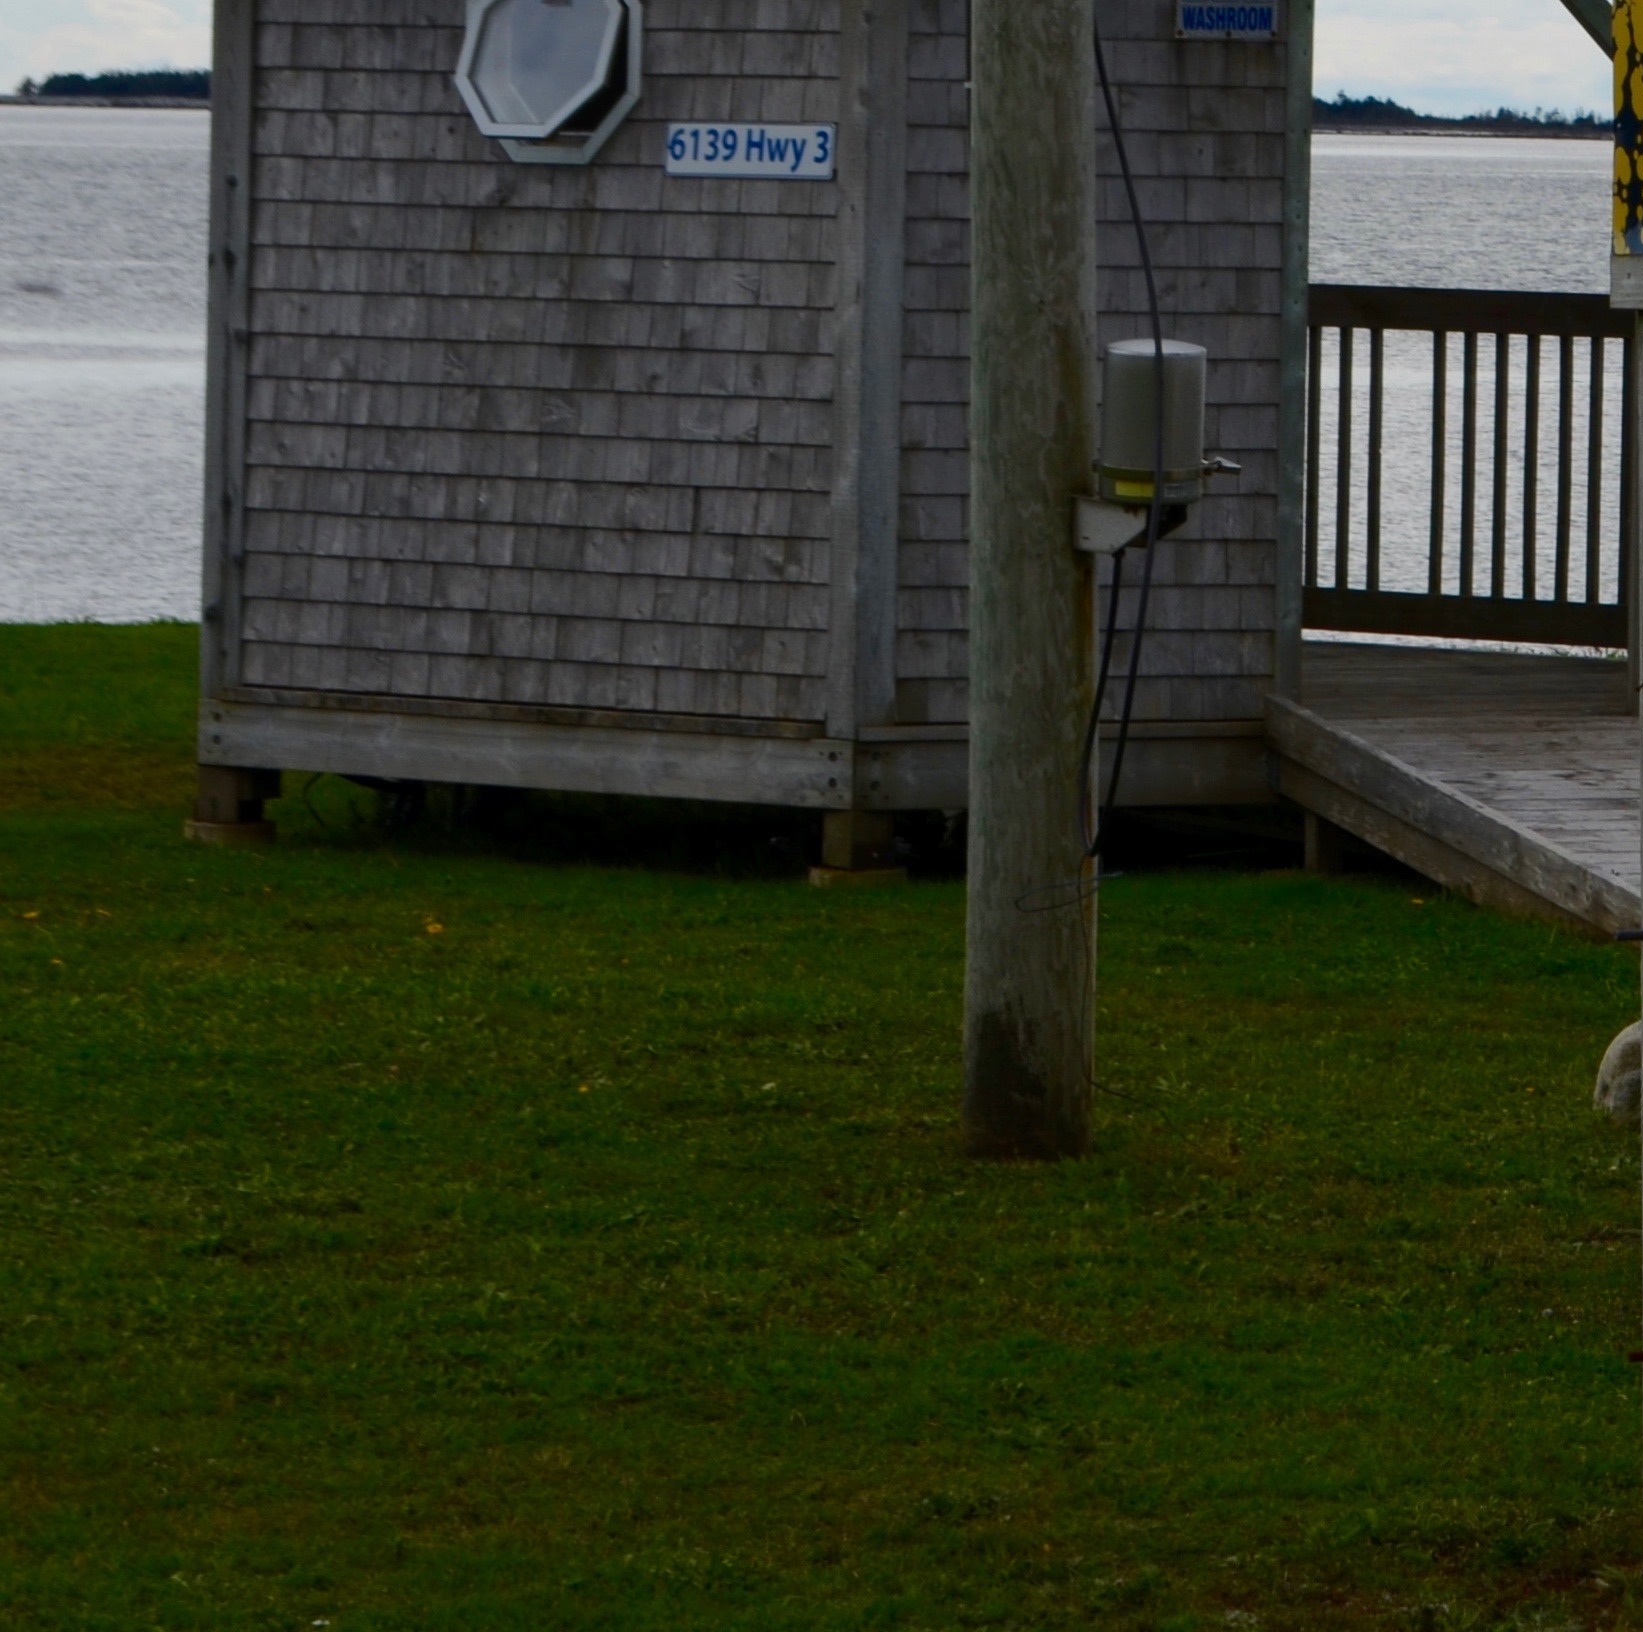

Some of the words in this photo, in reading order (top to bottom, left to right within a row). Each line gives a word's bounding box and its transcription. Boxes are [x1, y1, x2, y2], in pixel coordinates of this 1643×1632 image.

[1182, 6, 1272, 30] WASHROOM
[667, 128, 738, 161] 6139
[745, 129, 806, 172] Hwy
[813, 131, 829, 163] 3
